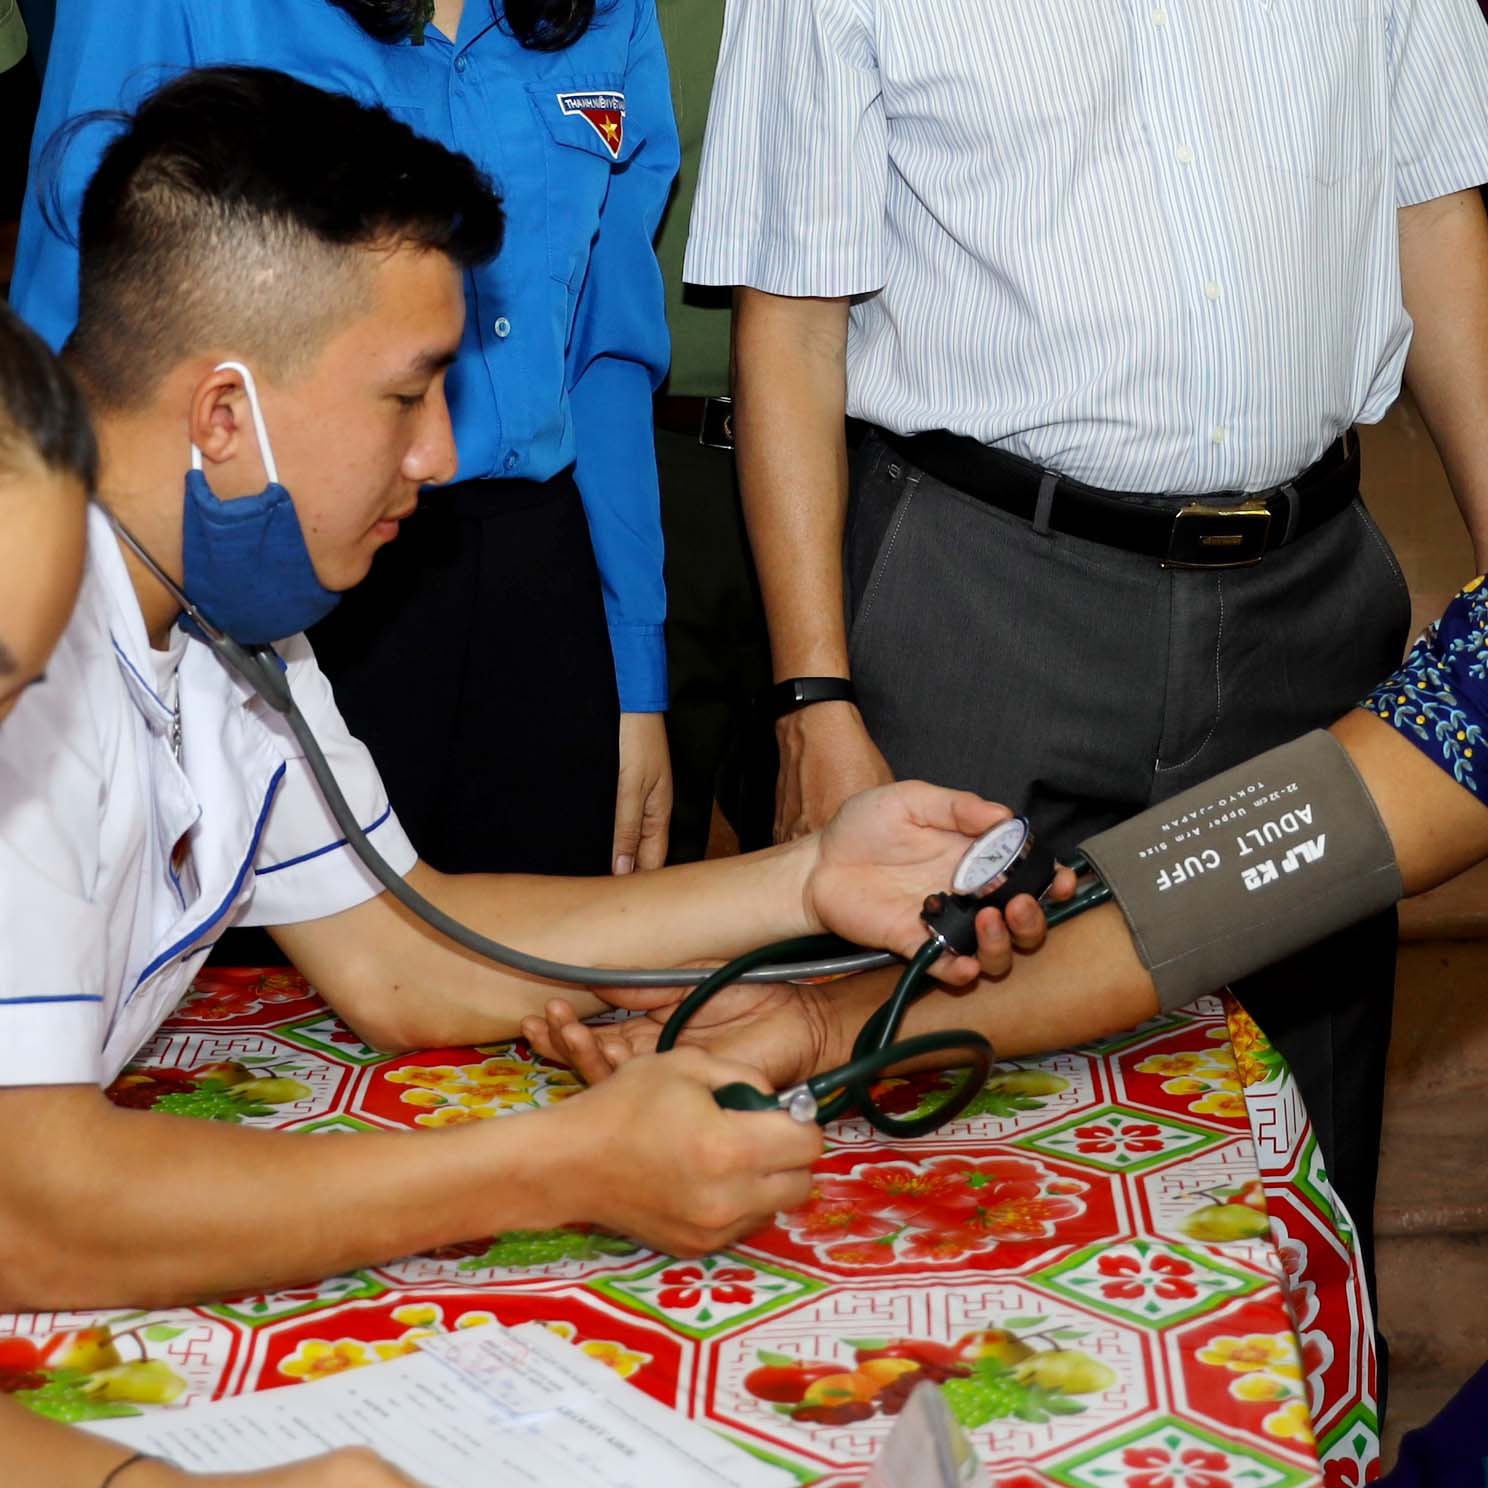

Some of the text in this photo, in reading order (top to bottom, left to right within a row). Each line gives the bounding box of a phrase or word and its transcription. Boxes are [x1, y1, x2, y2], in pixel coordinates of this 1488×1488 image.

[1208, 807, 1246, 829] Upper
[1174, 827, 1200, 843] Arm
[1138, 842, 1168, 859] Size
[1155, 803, 1313, 892] ADULT CUFF
